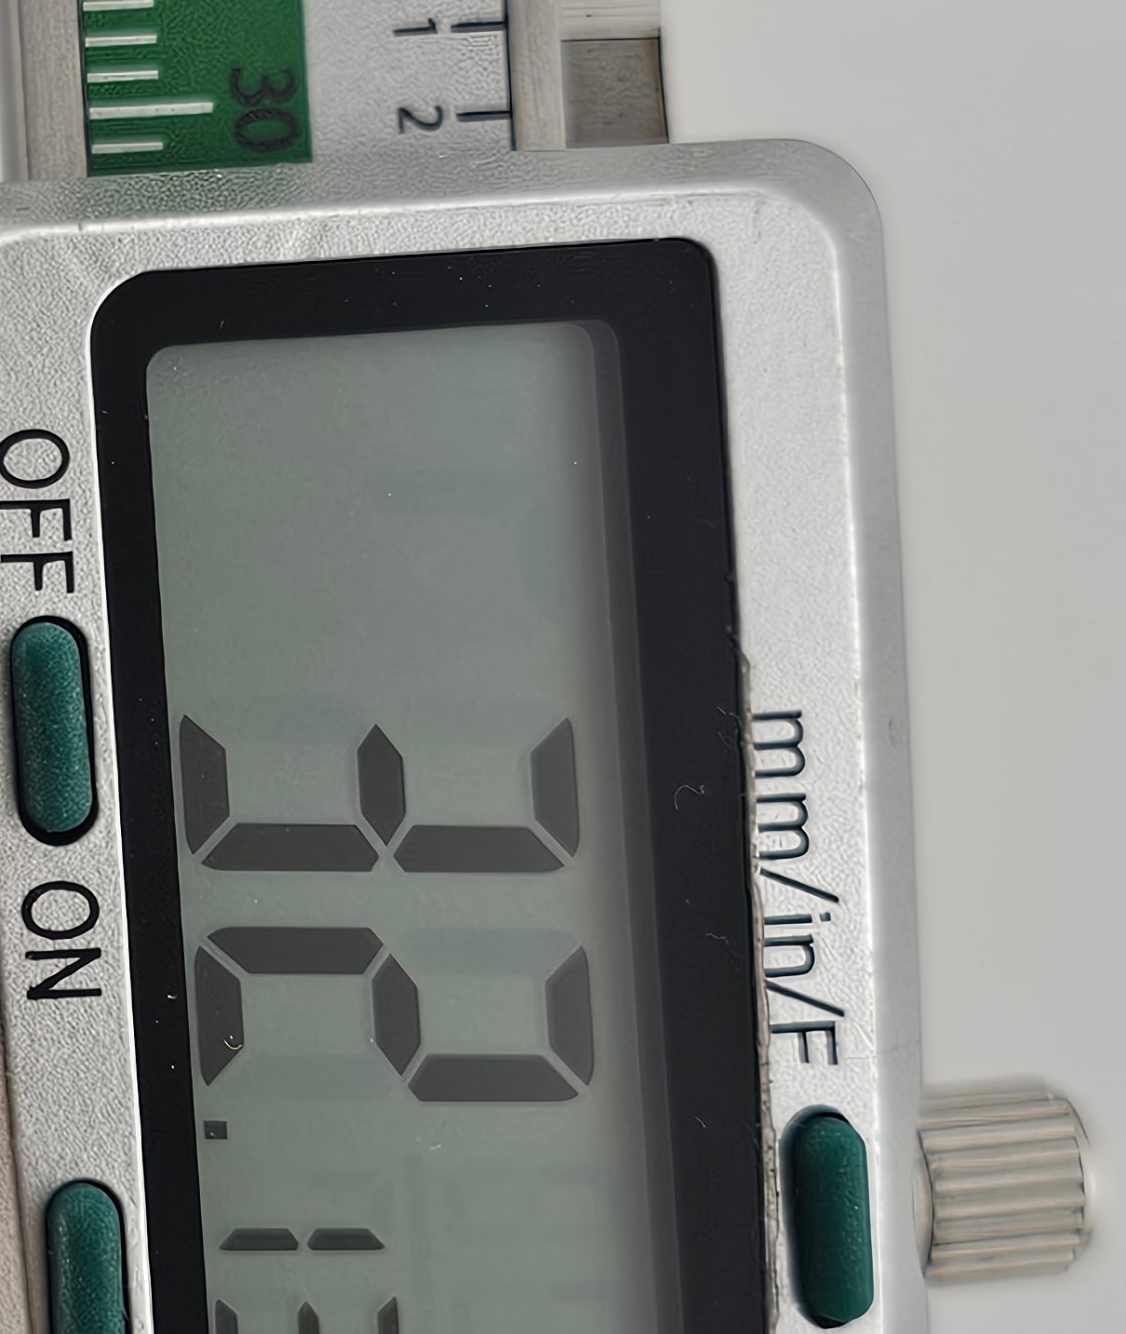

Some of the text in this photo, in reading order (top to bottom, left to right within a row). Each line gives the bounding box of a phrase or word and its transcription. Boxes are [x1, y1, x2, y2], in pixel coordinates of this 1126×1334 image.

[392, 17, 438, 36] 1
[229, 68, 300, 154] 30
[397, 105, 444, 134] 2
[750, 708, 846, 1067] mm/in/F
[21, 880, 102, 1000] ON
